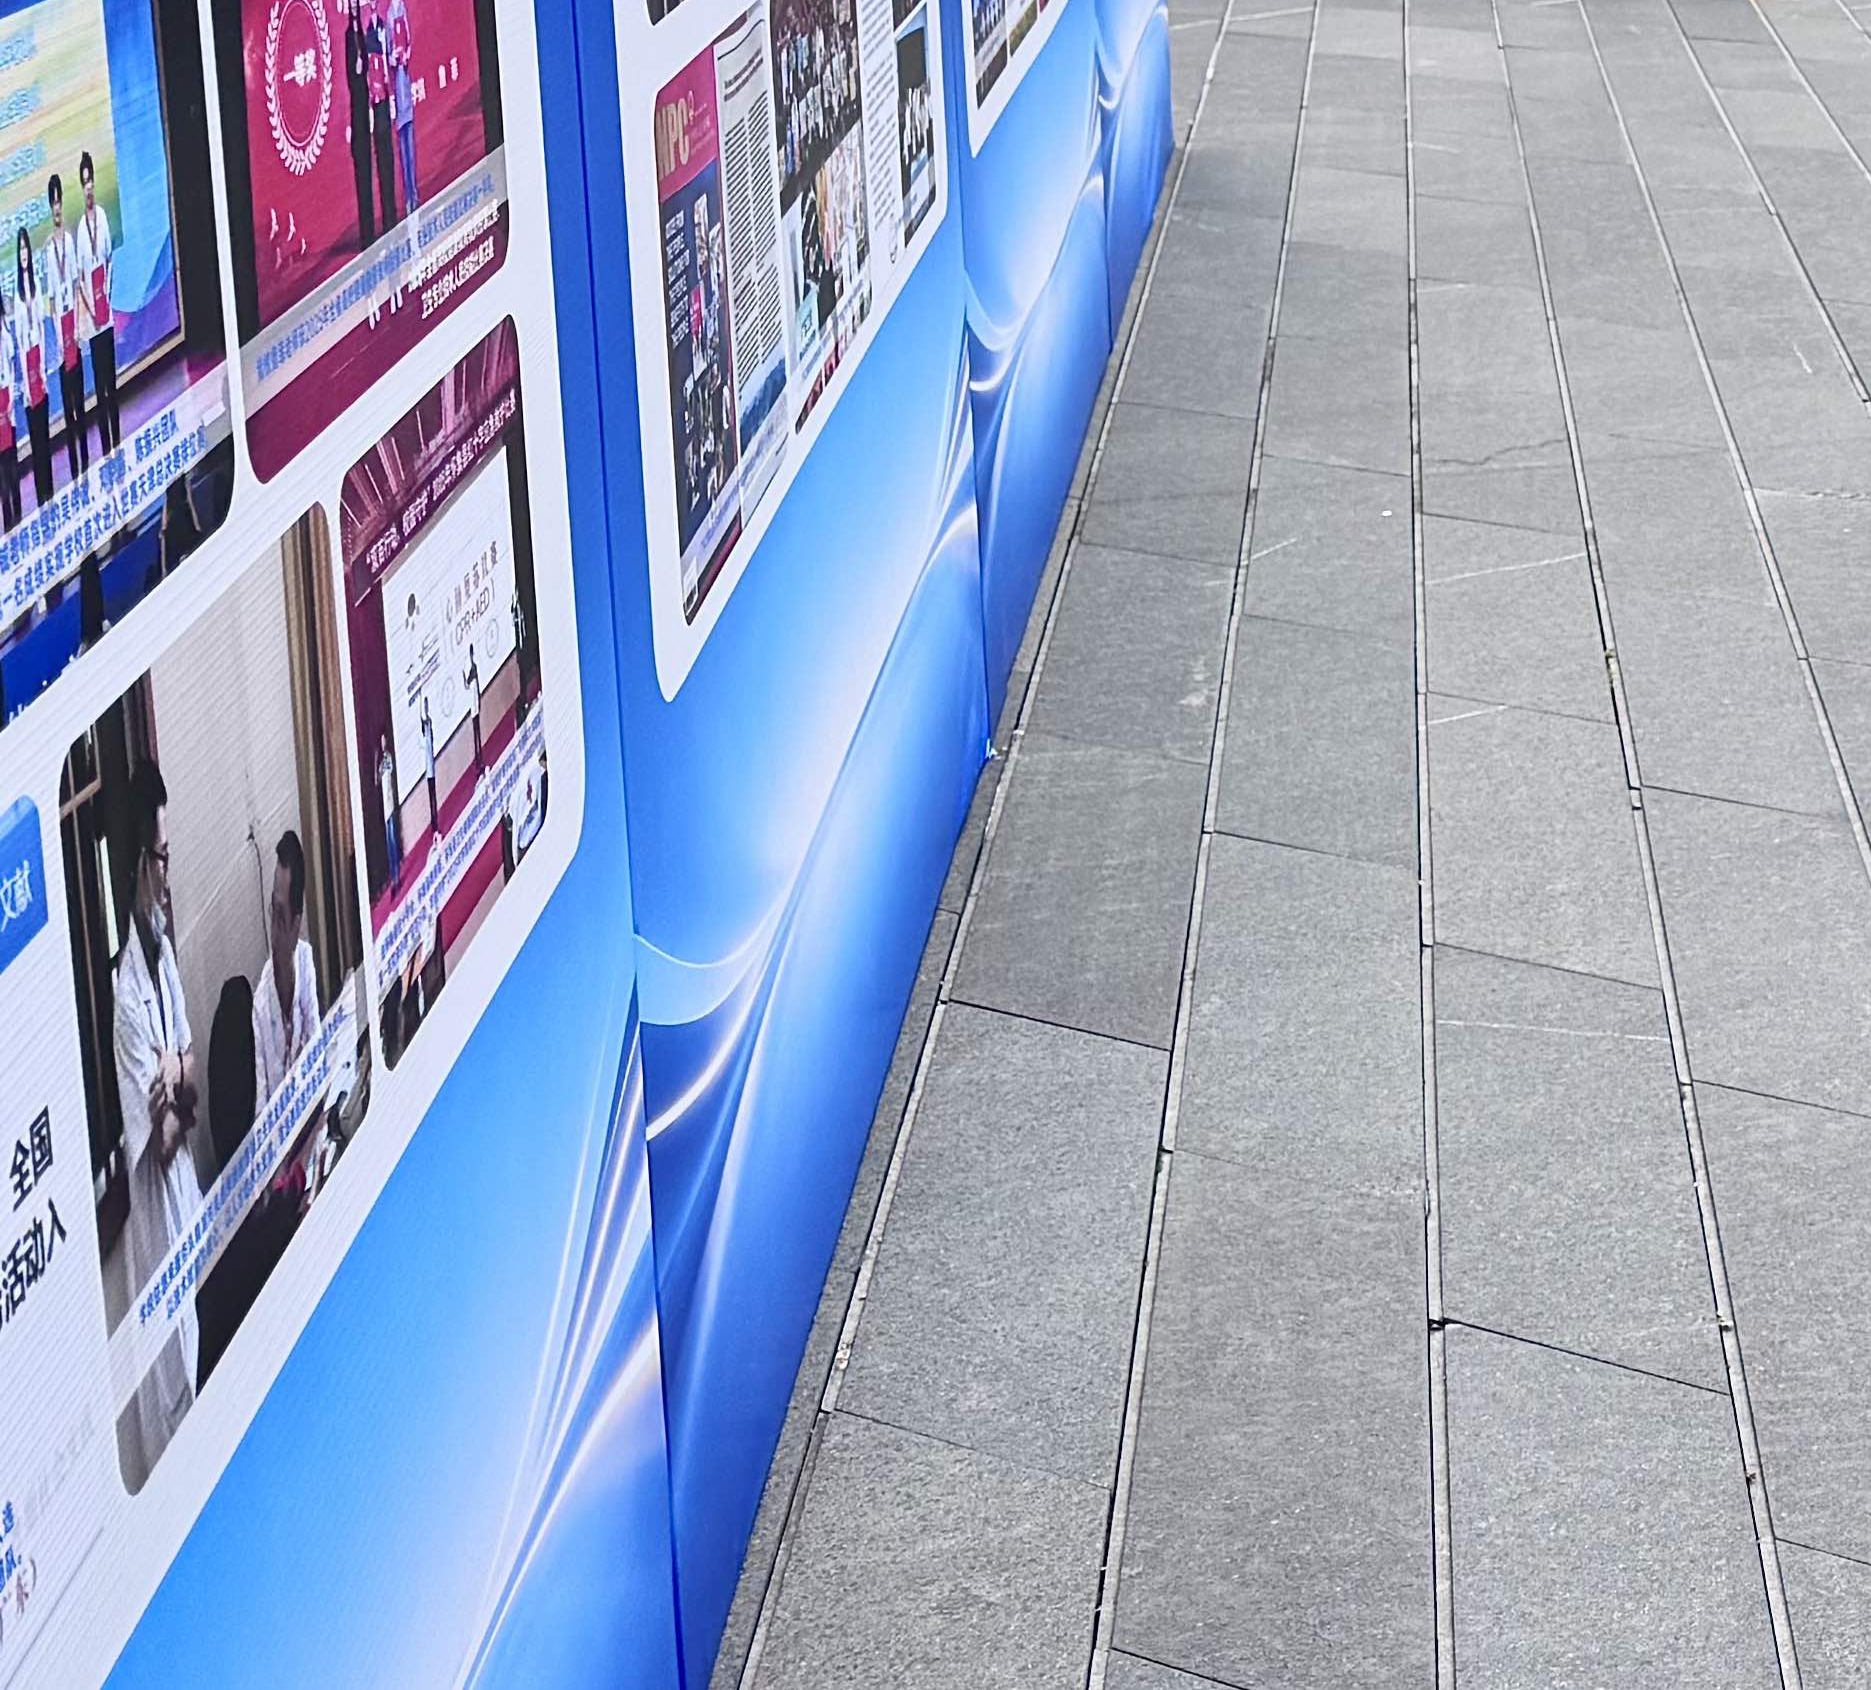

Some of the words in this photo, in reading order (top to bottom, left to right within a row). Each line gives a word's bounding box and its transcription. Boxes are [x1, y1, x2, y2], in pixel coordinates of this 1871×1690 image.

[284, 47, 319, 106] 一等奖
[9, 1105, 55, 1215] 全国
